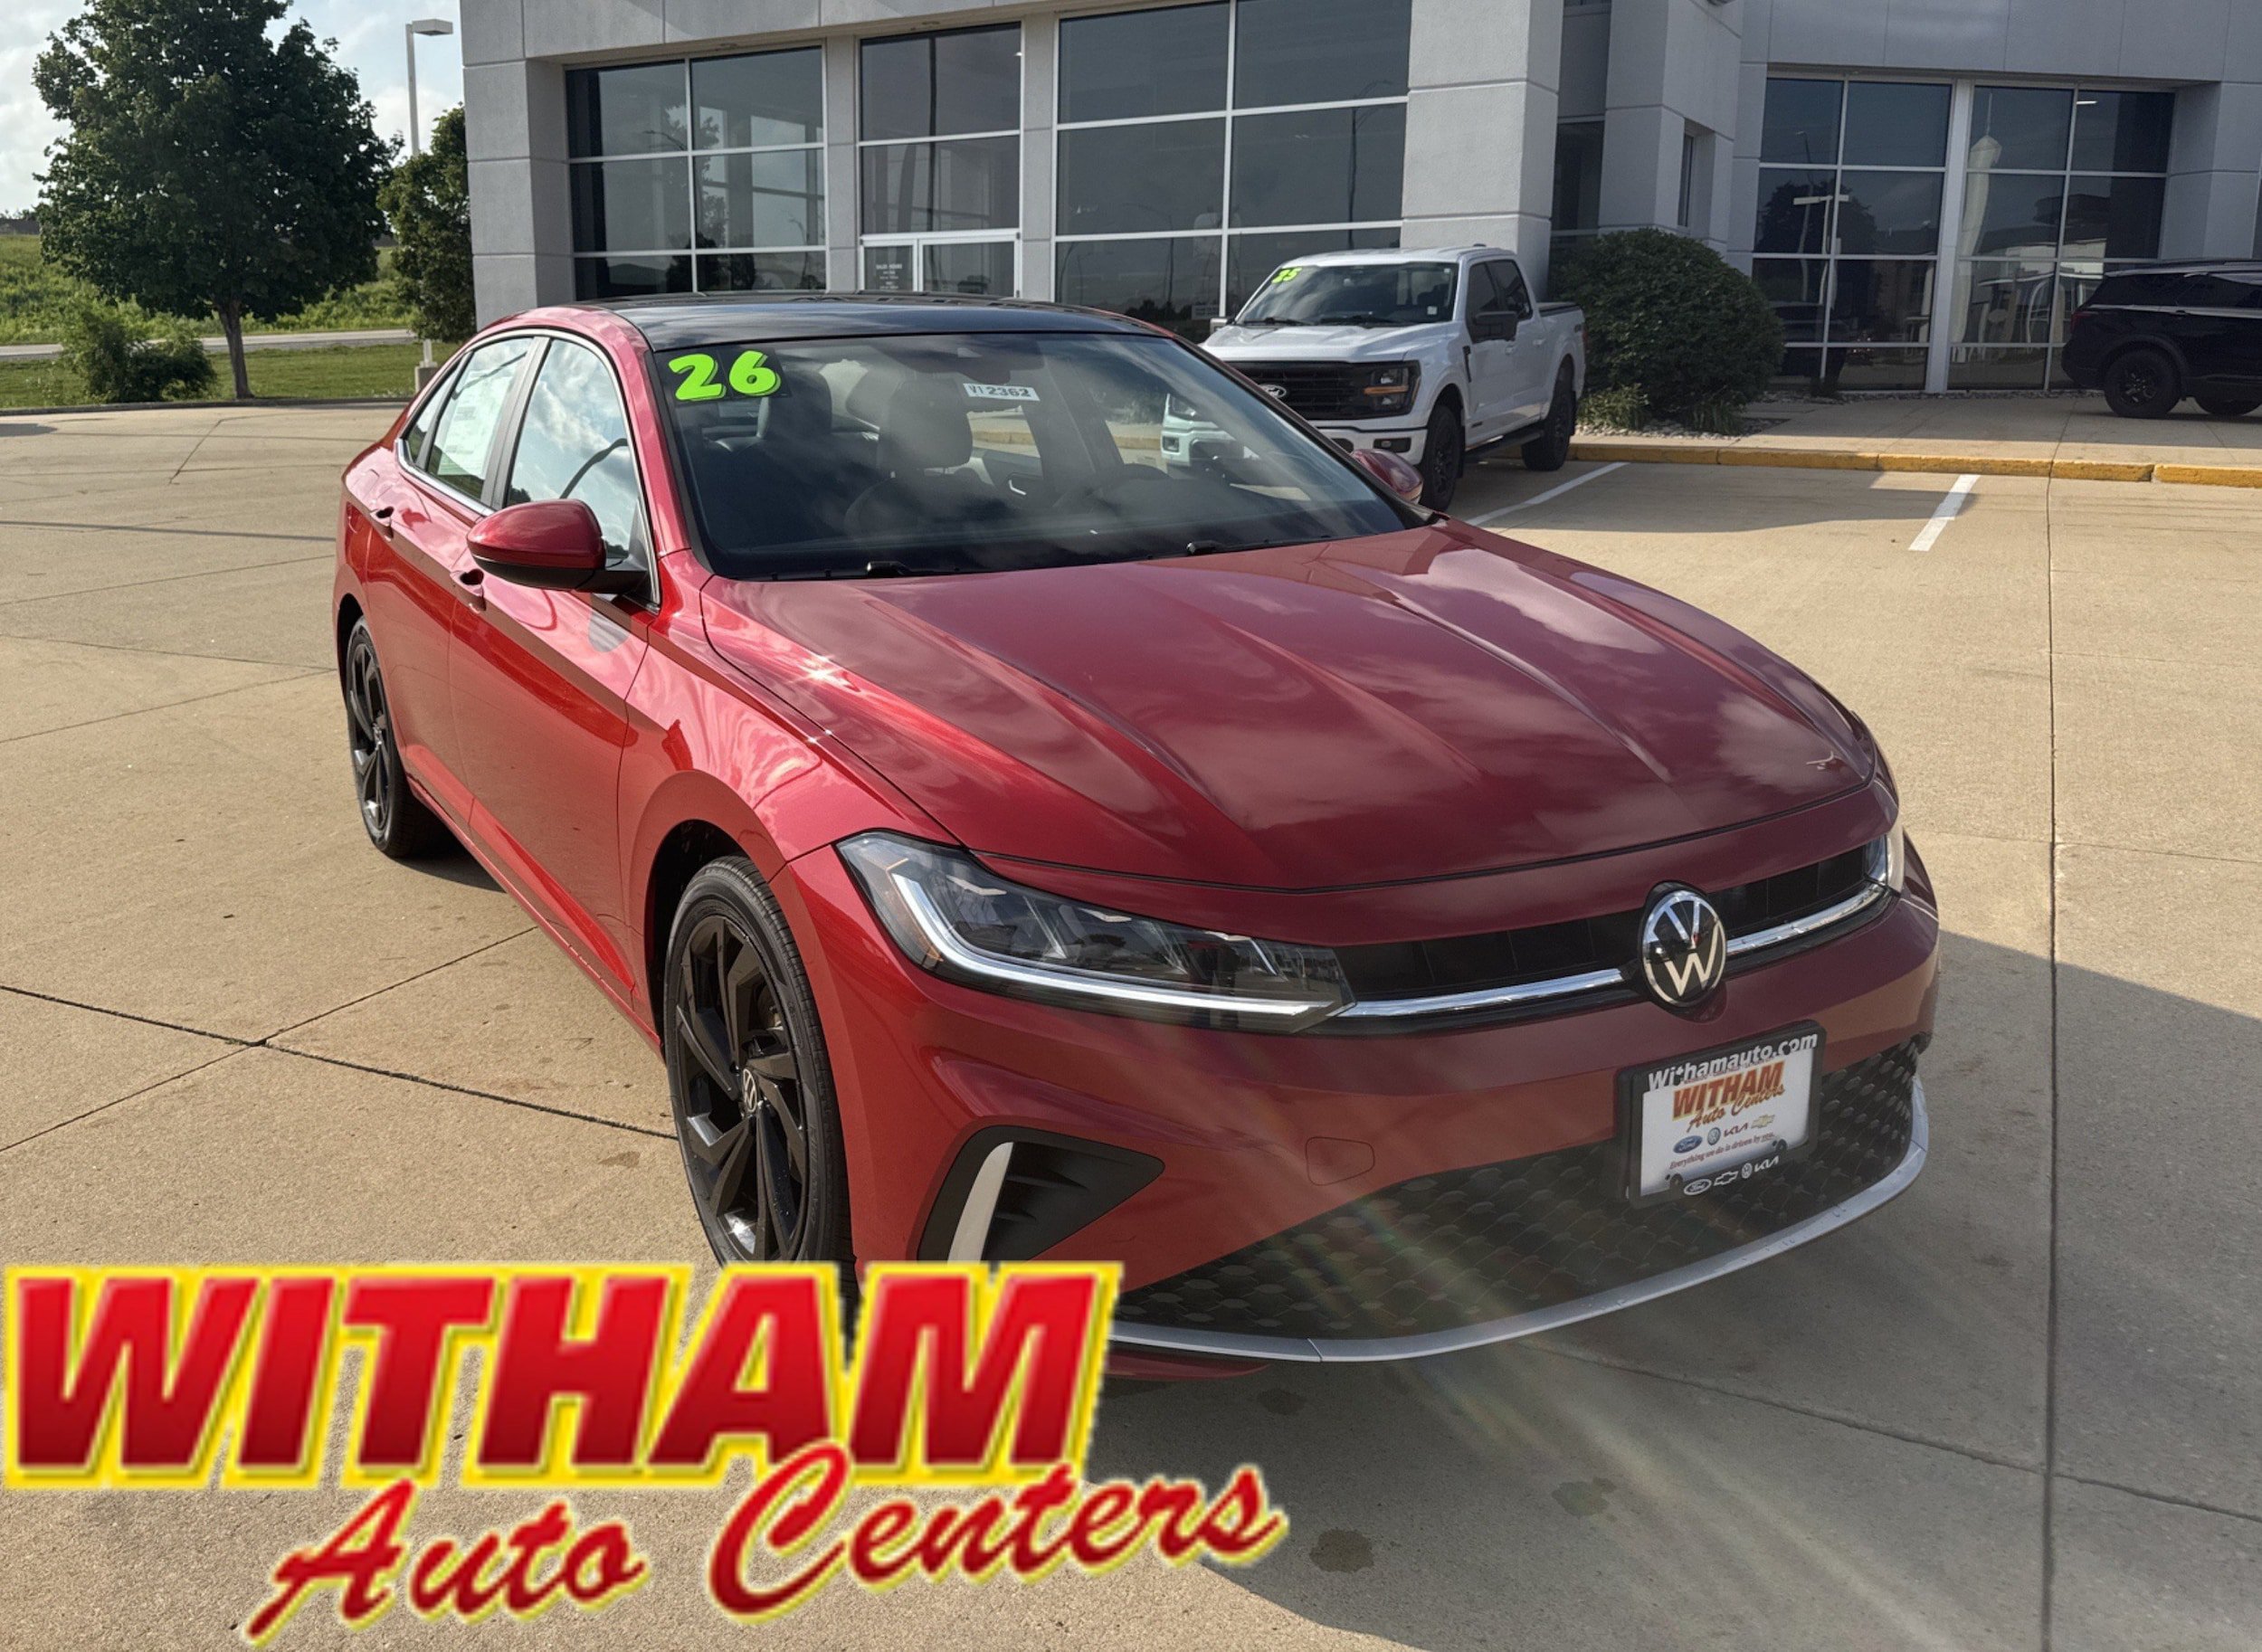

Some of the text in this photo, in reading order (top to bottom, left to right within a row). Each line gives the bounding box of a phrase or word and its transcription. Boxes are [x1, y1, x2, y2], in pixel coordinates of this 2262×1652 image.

[1271, 266, 1303, 284] 25
[668, 350, 782, 401] 26
[1648, 1032, 1818, 1090] Withamauto.com
[1673, 1061, 1784, 1120] WITHAM
[1687, 1083, 1785, 1133] Auto Centers
